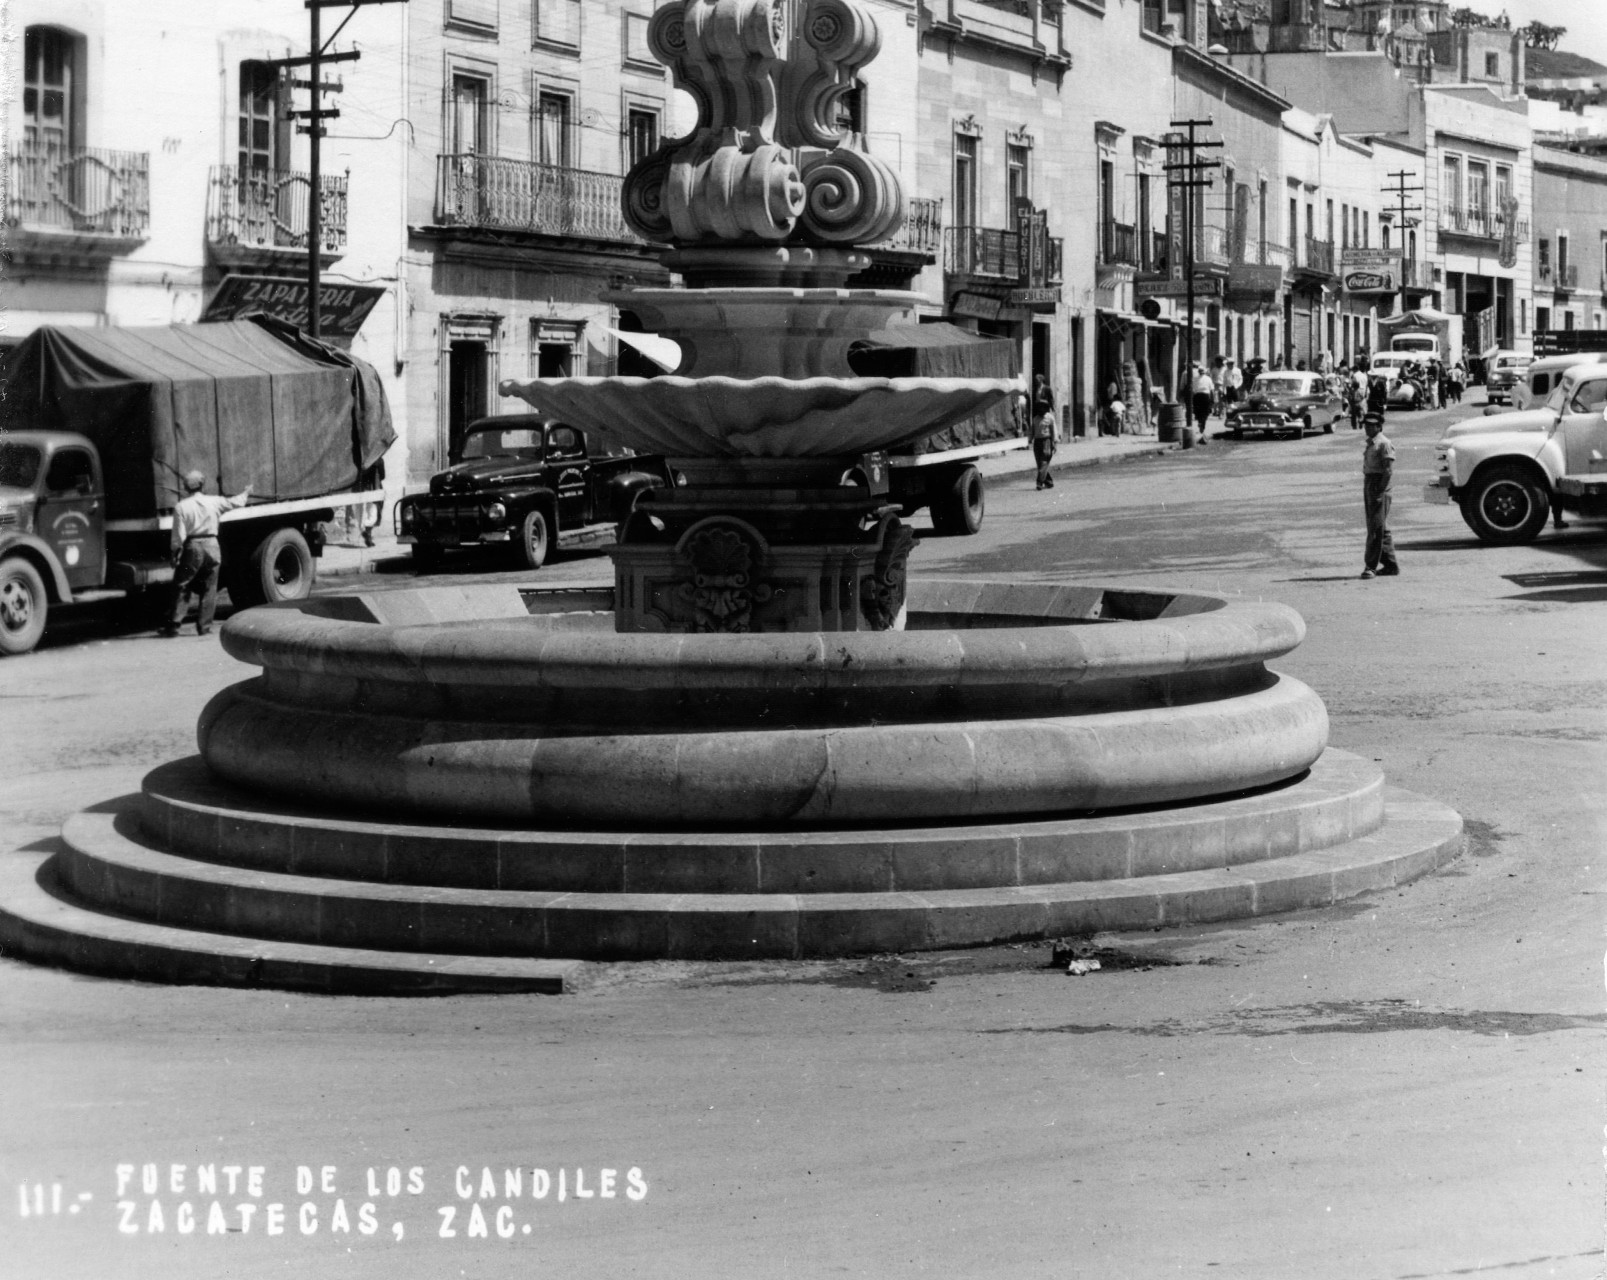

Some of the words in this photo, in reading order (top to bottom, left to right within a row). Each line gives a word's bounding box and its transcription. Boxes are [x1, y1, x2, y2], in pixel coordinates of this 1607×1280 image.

[1018, 207, 1030, 218] EL
[1171, 133, 1183, 279] MUEBLERIA
[1021, 218, 1029, 275] PUERTO
